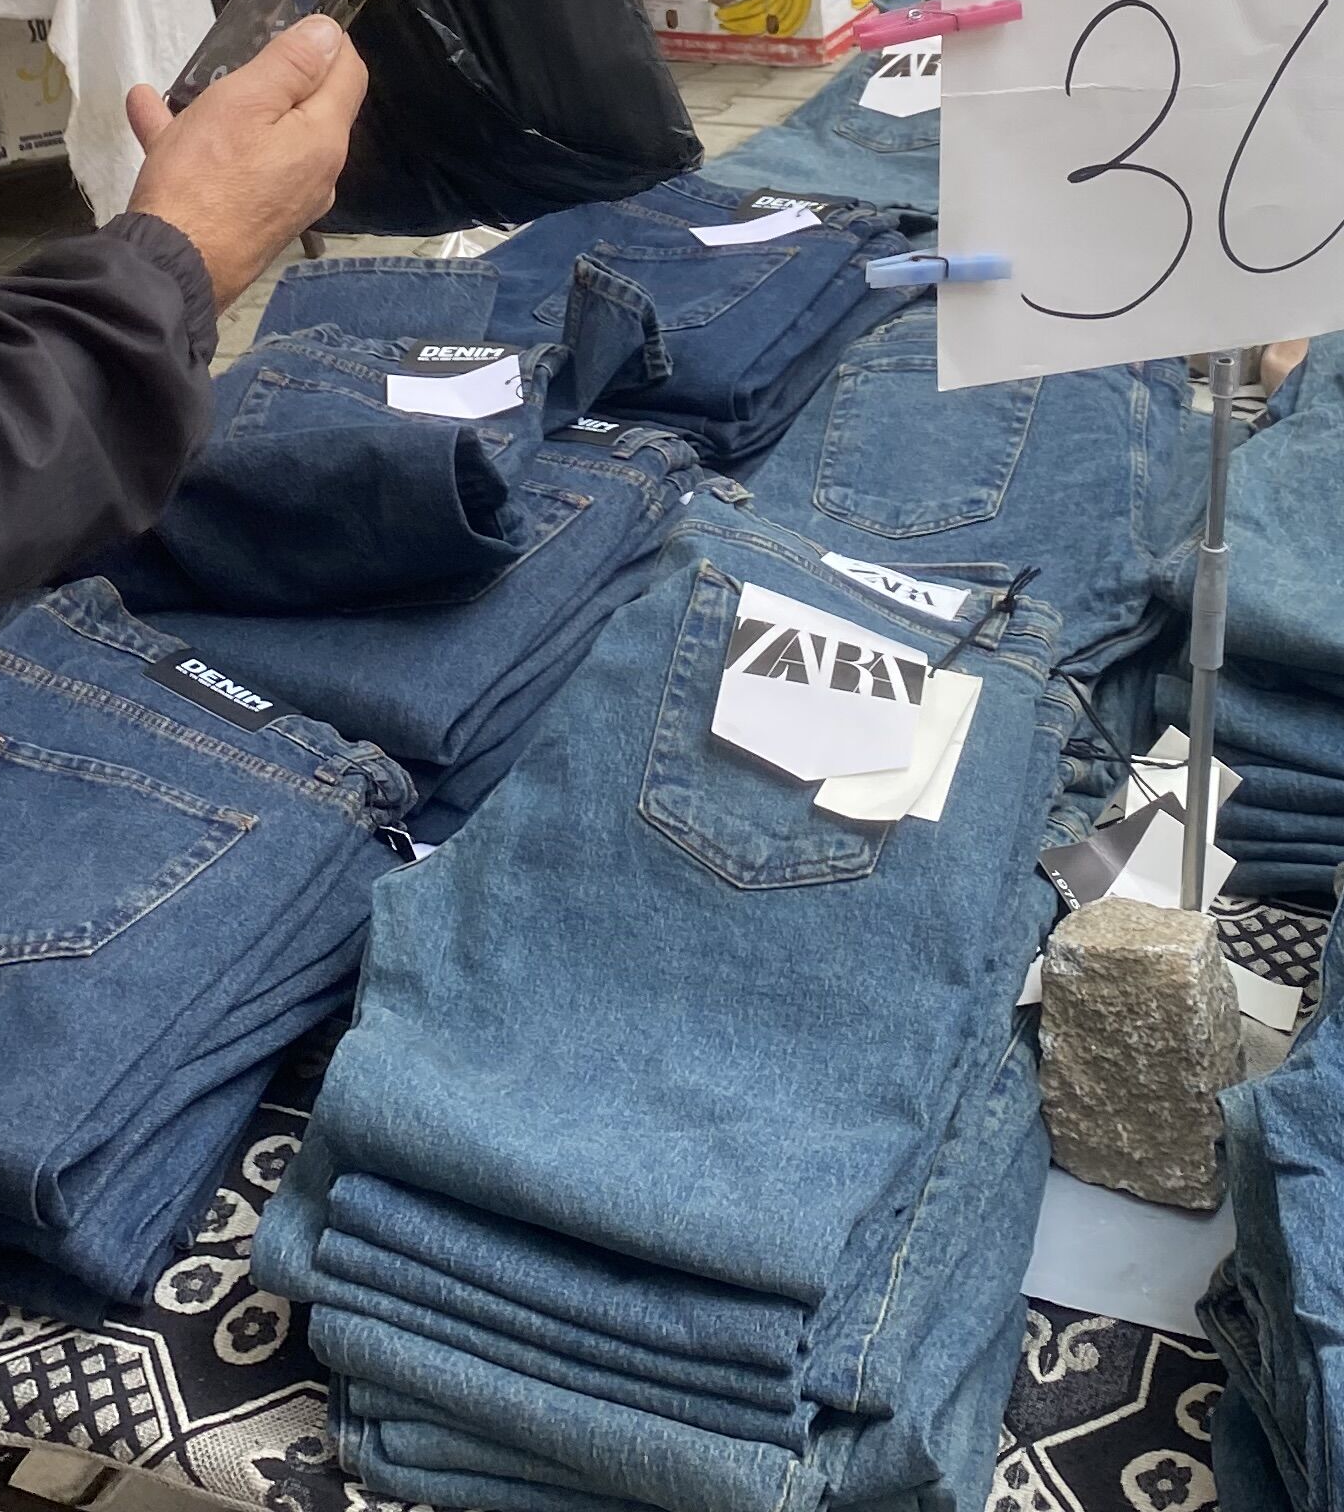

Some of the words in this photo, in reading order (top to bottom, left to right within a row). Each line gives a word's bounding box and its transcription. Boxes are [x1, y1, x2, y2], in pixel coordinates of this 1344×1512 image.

[419, 346, 505, 358] DENIM
[846, 567, 936, 607] ZARA
[726, 616, 924, 705] ZARA
[180, 658, 274, 711] DENIM
